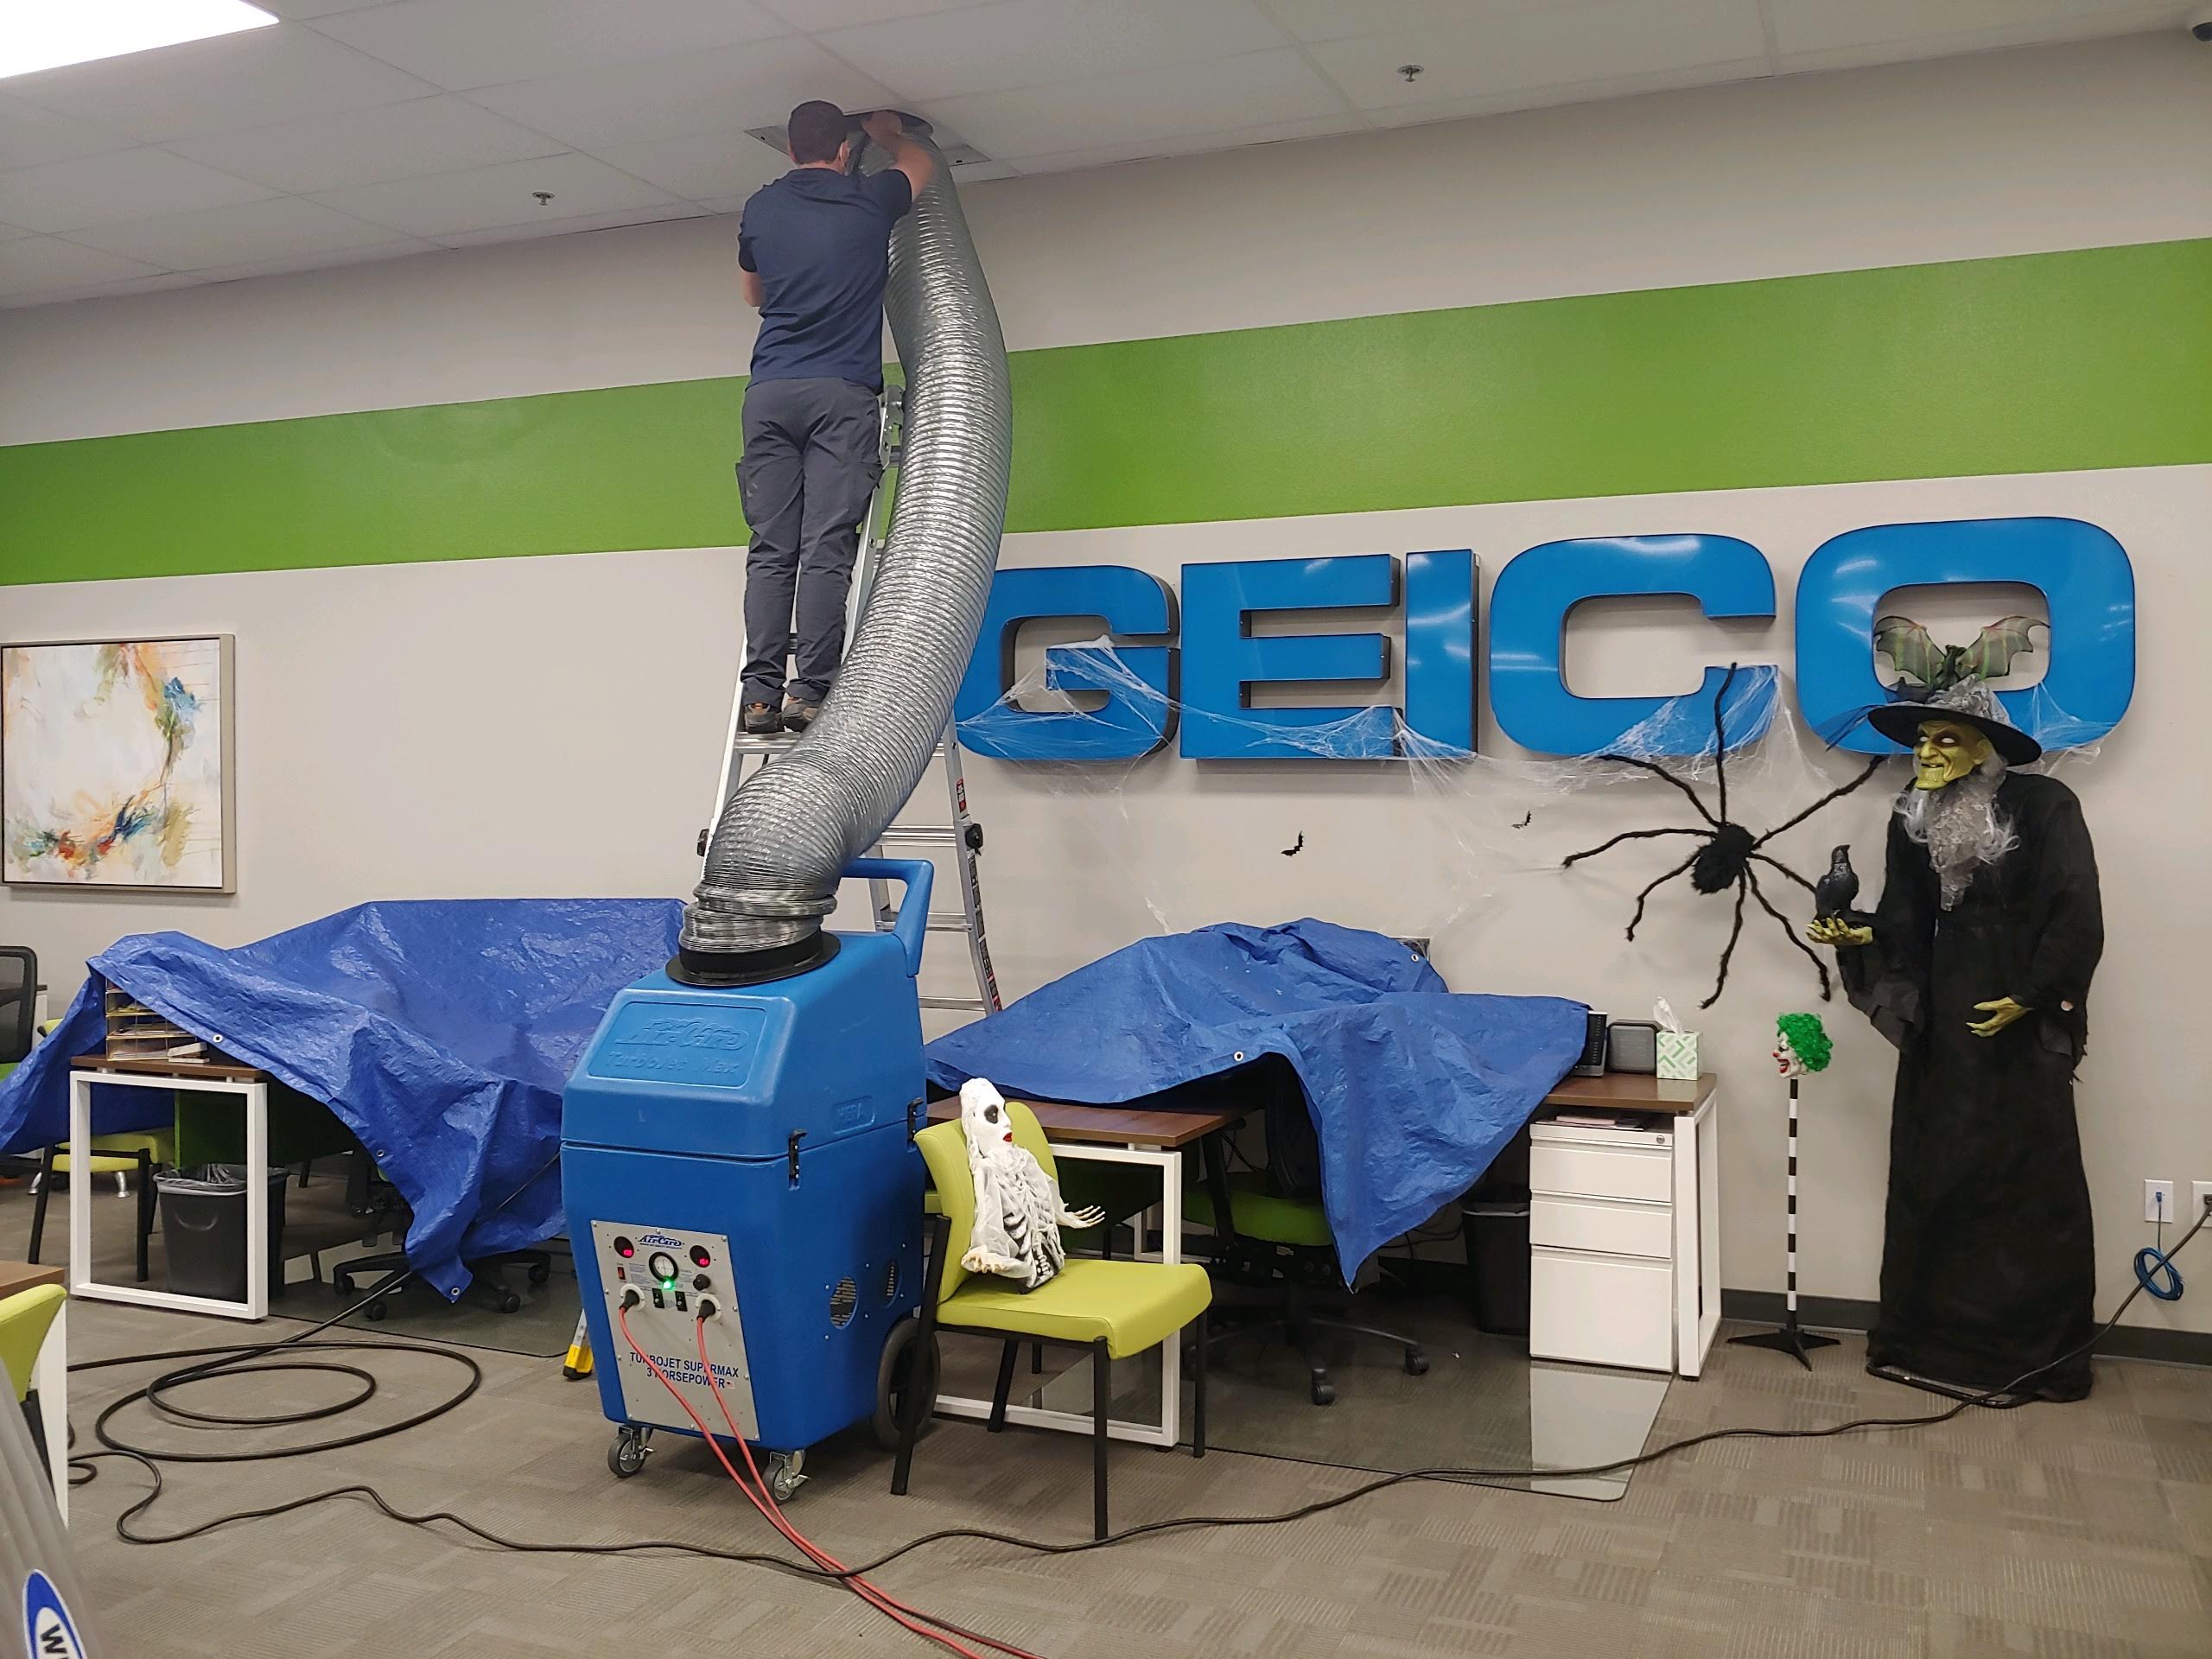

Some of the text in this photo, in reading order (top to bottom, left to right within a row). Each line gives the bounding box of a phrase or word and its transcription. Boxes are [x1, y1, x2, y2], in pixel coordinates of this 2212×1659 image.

[955, 516, 2135, 762] GEICO
[630, 1352, 739, 1377] TUBOJET SUPRMAX
[646, 1367, 652, 1377] 3
